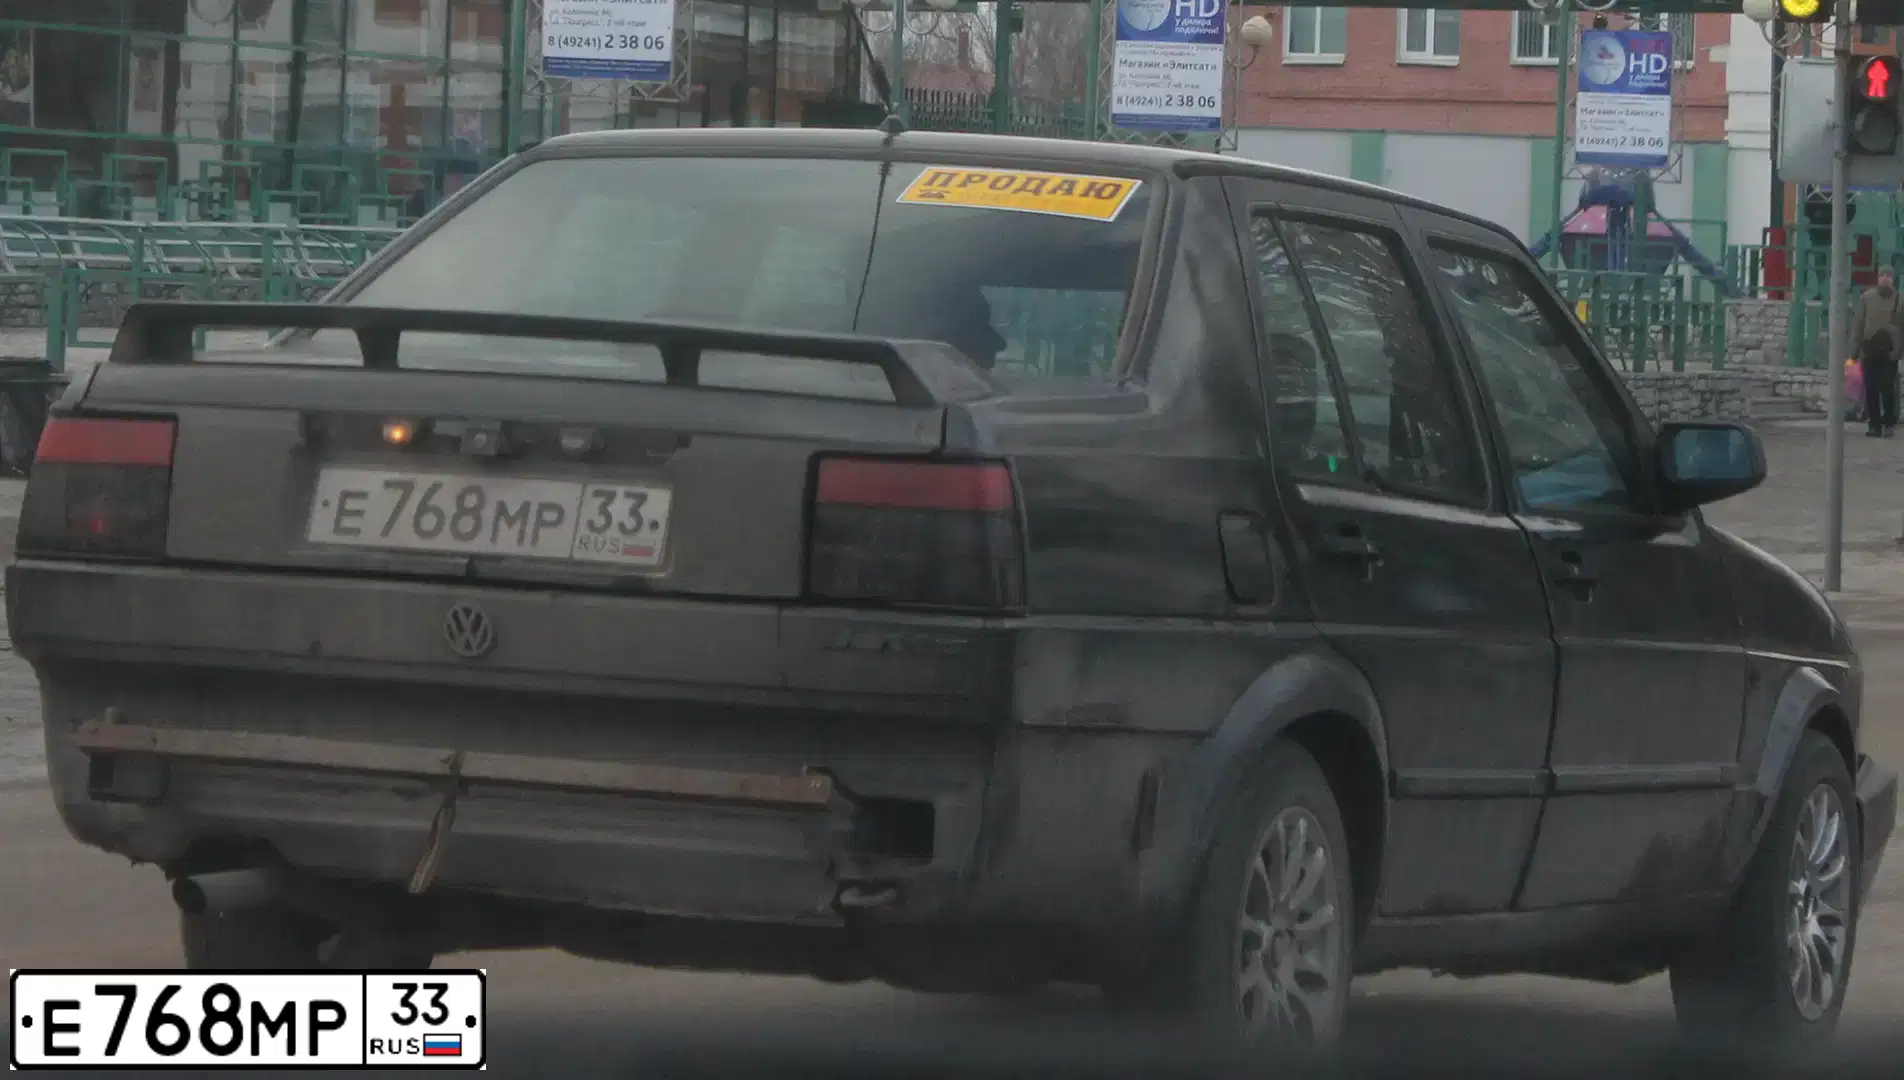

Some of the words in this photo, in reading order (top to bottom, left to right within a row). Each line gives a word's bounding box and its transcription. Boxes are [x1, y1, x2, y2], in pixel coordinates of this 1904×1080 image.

[1175, 0, 1220, 18] HD
[548, 35, 555, 46] 8
[558, 35, 601, 51] (49241)
[604, 34, 614, 48] 2
[618, 35, 639, 49] 38
[643, 35, 665, 50] 06
[1119, 59, 1160, 69] Магазин
[1629, 52, 1667, 73] HD
[1165, 94, 1173, 106] 2
[1177, 95, 1194, 107] 38
[1198, 96, 1216, 108] 06
[1620, 136, 1627, 146] 2
[1630, 136, 1645, 147] 38
[1647, 137, 1664, 148] 06
[922, 171, 1123, 200] ПРОДАЮ
[332, 479, 566, 547] E768MP
[586, 489, 650, 535] 33
[578, 535, 621, 554] RUS
